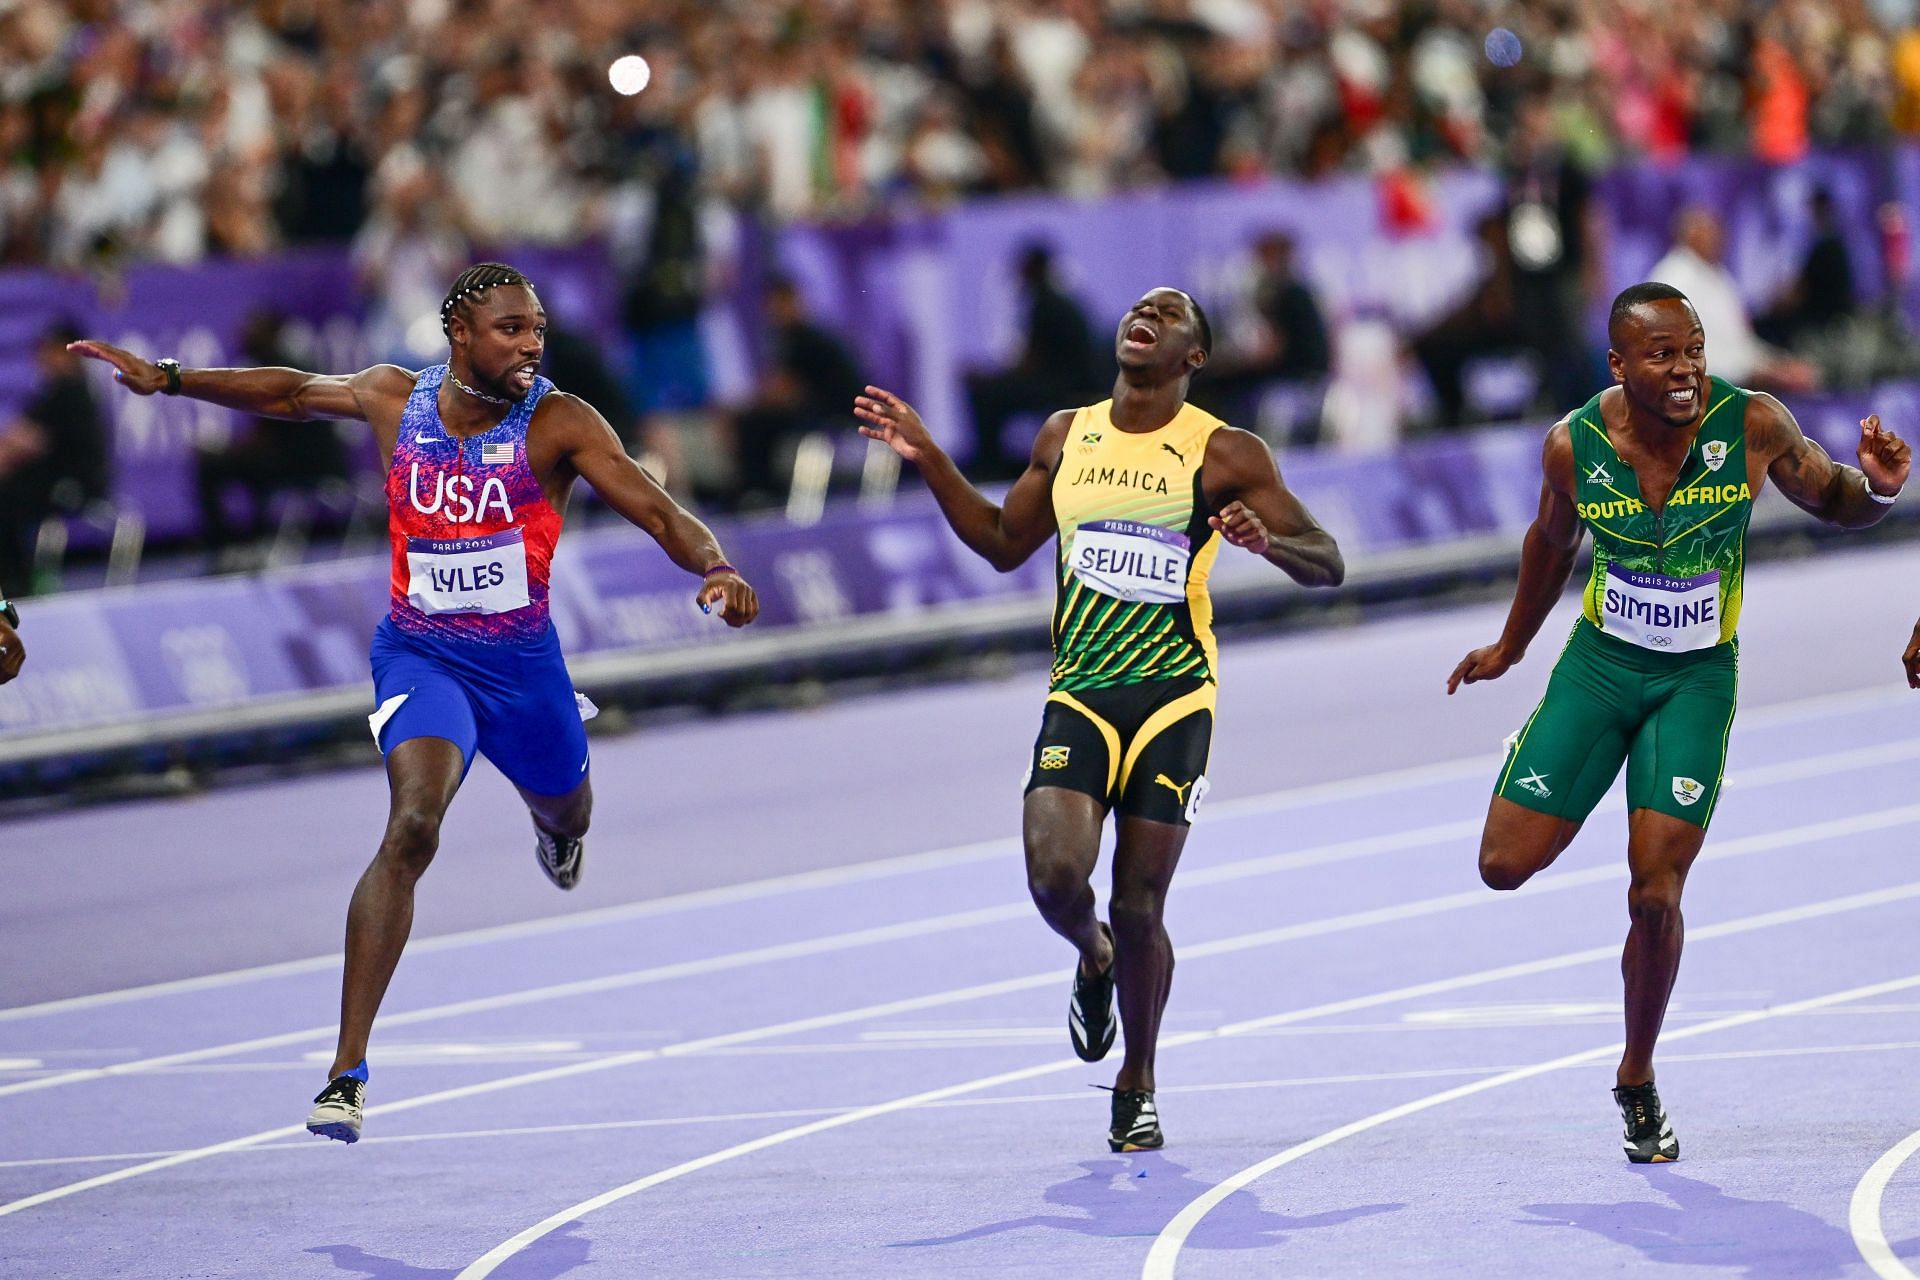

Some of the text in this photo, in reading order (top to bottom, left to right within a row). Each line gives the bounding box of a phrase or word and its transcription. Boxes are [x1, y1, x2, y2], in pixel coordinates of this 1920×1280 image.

[410, 462, 514, 523] USA
[1072, 467, 1168, 495] JAMAICA
[1576, 482, 1752, 520] SOUTH AFRICA
[432, 539, 493, 551] PARIS 2024
[1104, 521, 1164, 538] PARIS 2024
[431, 561, 504, 593] LYLES
[1078, 547, 1179, 583] SEVILLE
[1631, 575, 1692, 589] PARIS 2024
[1605, 588, 1714, 629] SIMBINE
